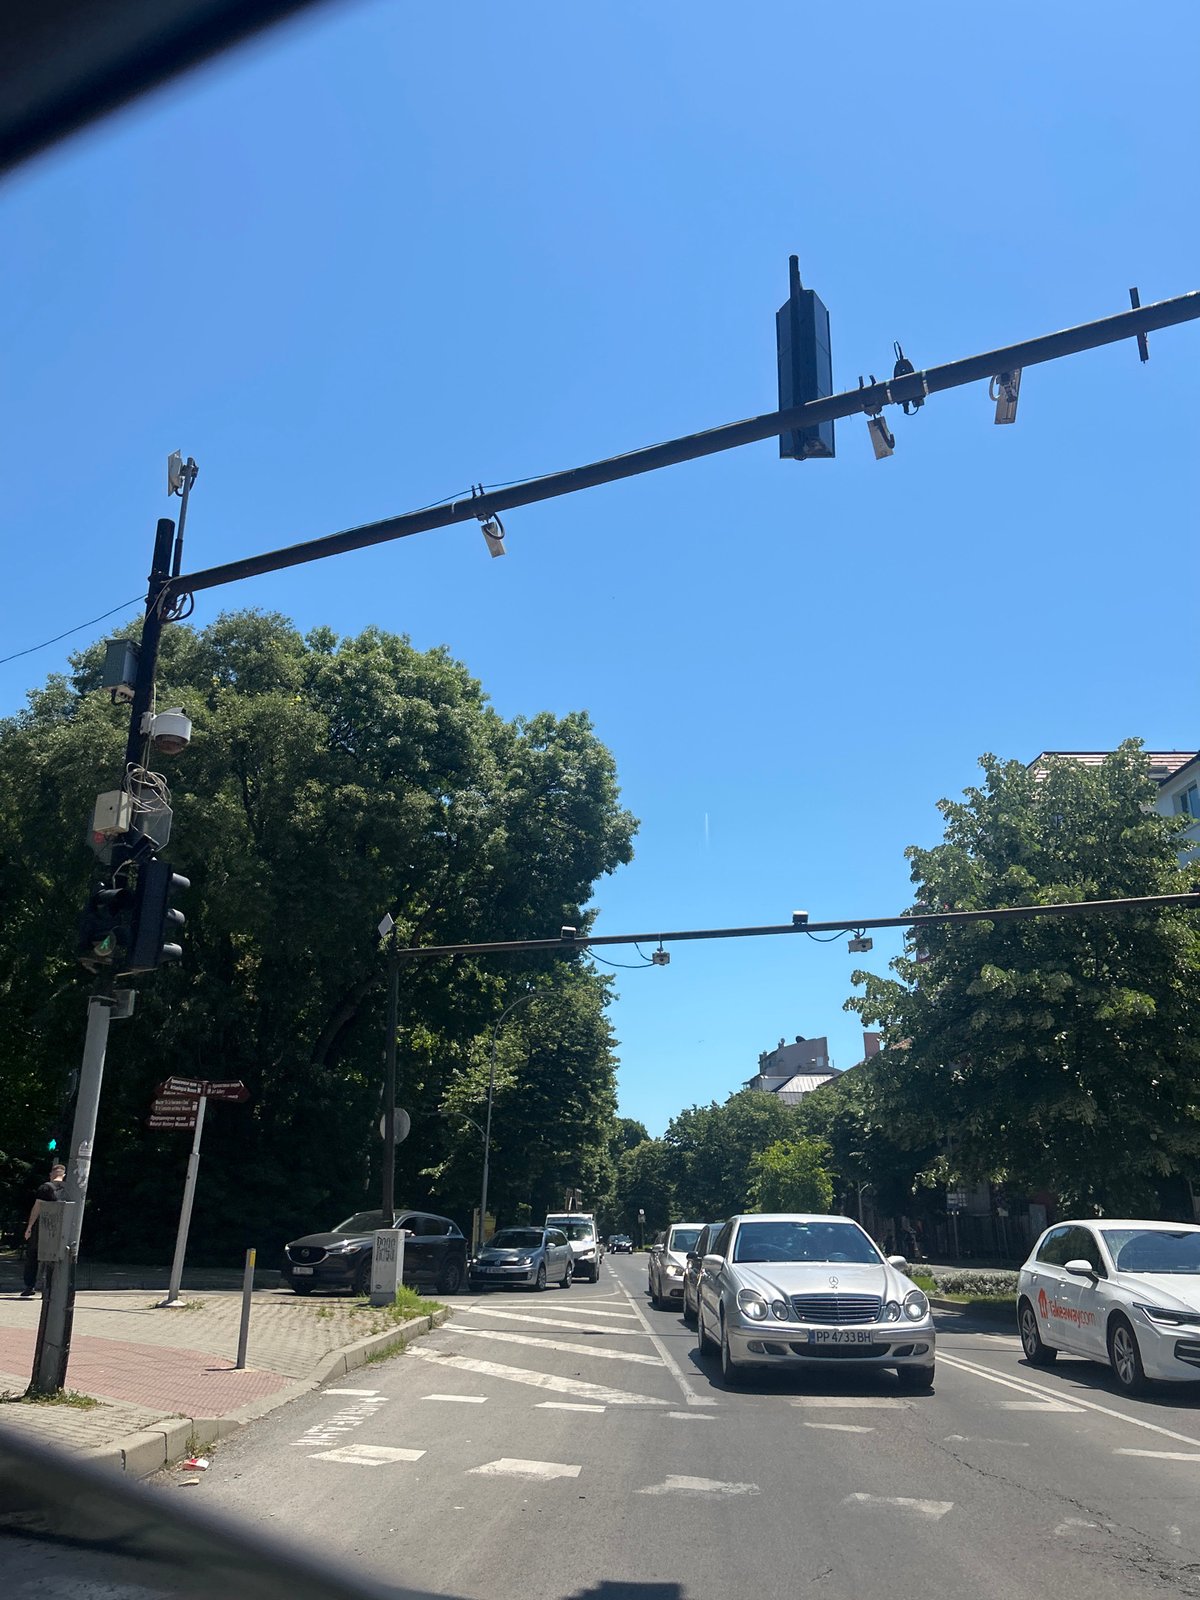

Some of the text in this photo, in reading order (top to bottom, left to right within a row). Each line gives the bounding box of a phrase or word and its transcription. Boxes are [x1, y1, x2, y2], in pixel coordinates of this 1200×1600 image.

[816, 1331, 871, 1343] PP 4733 BH
